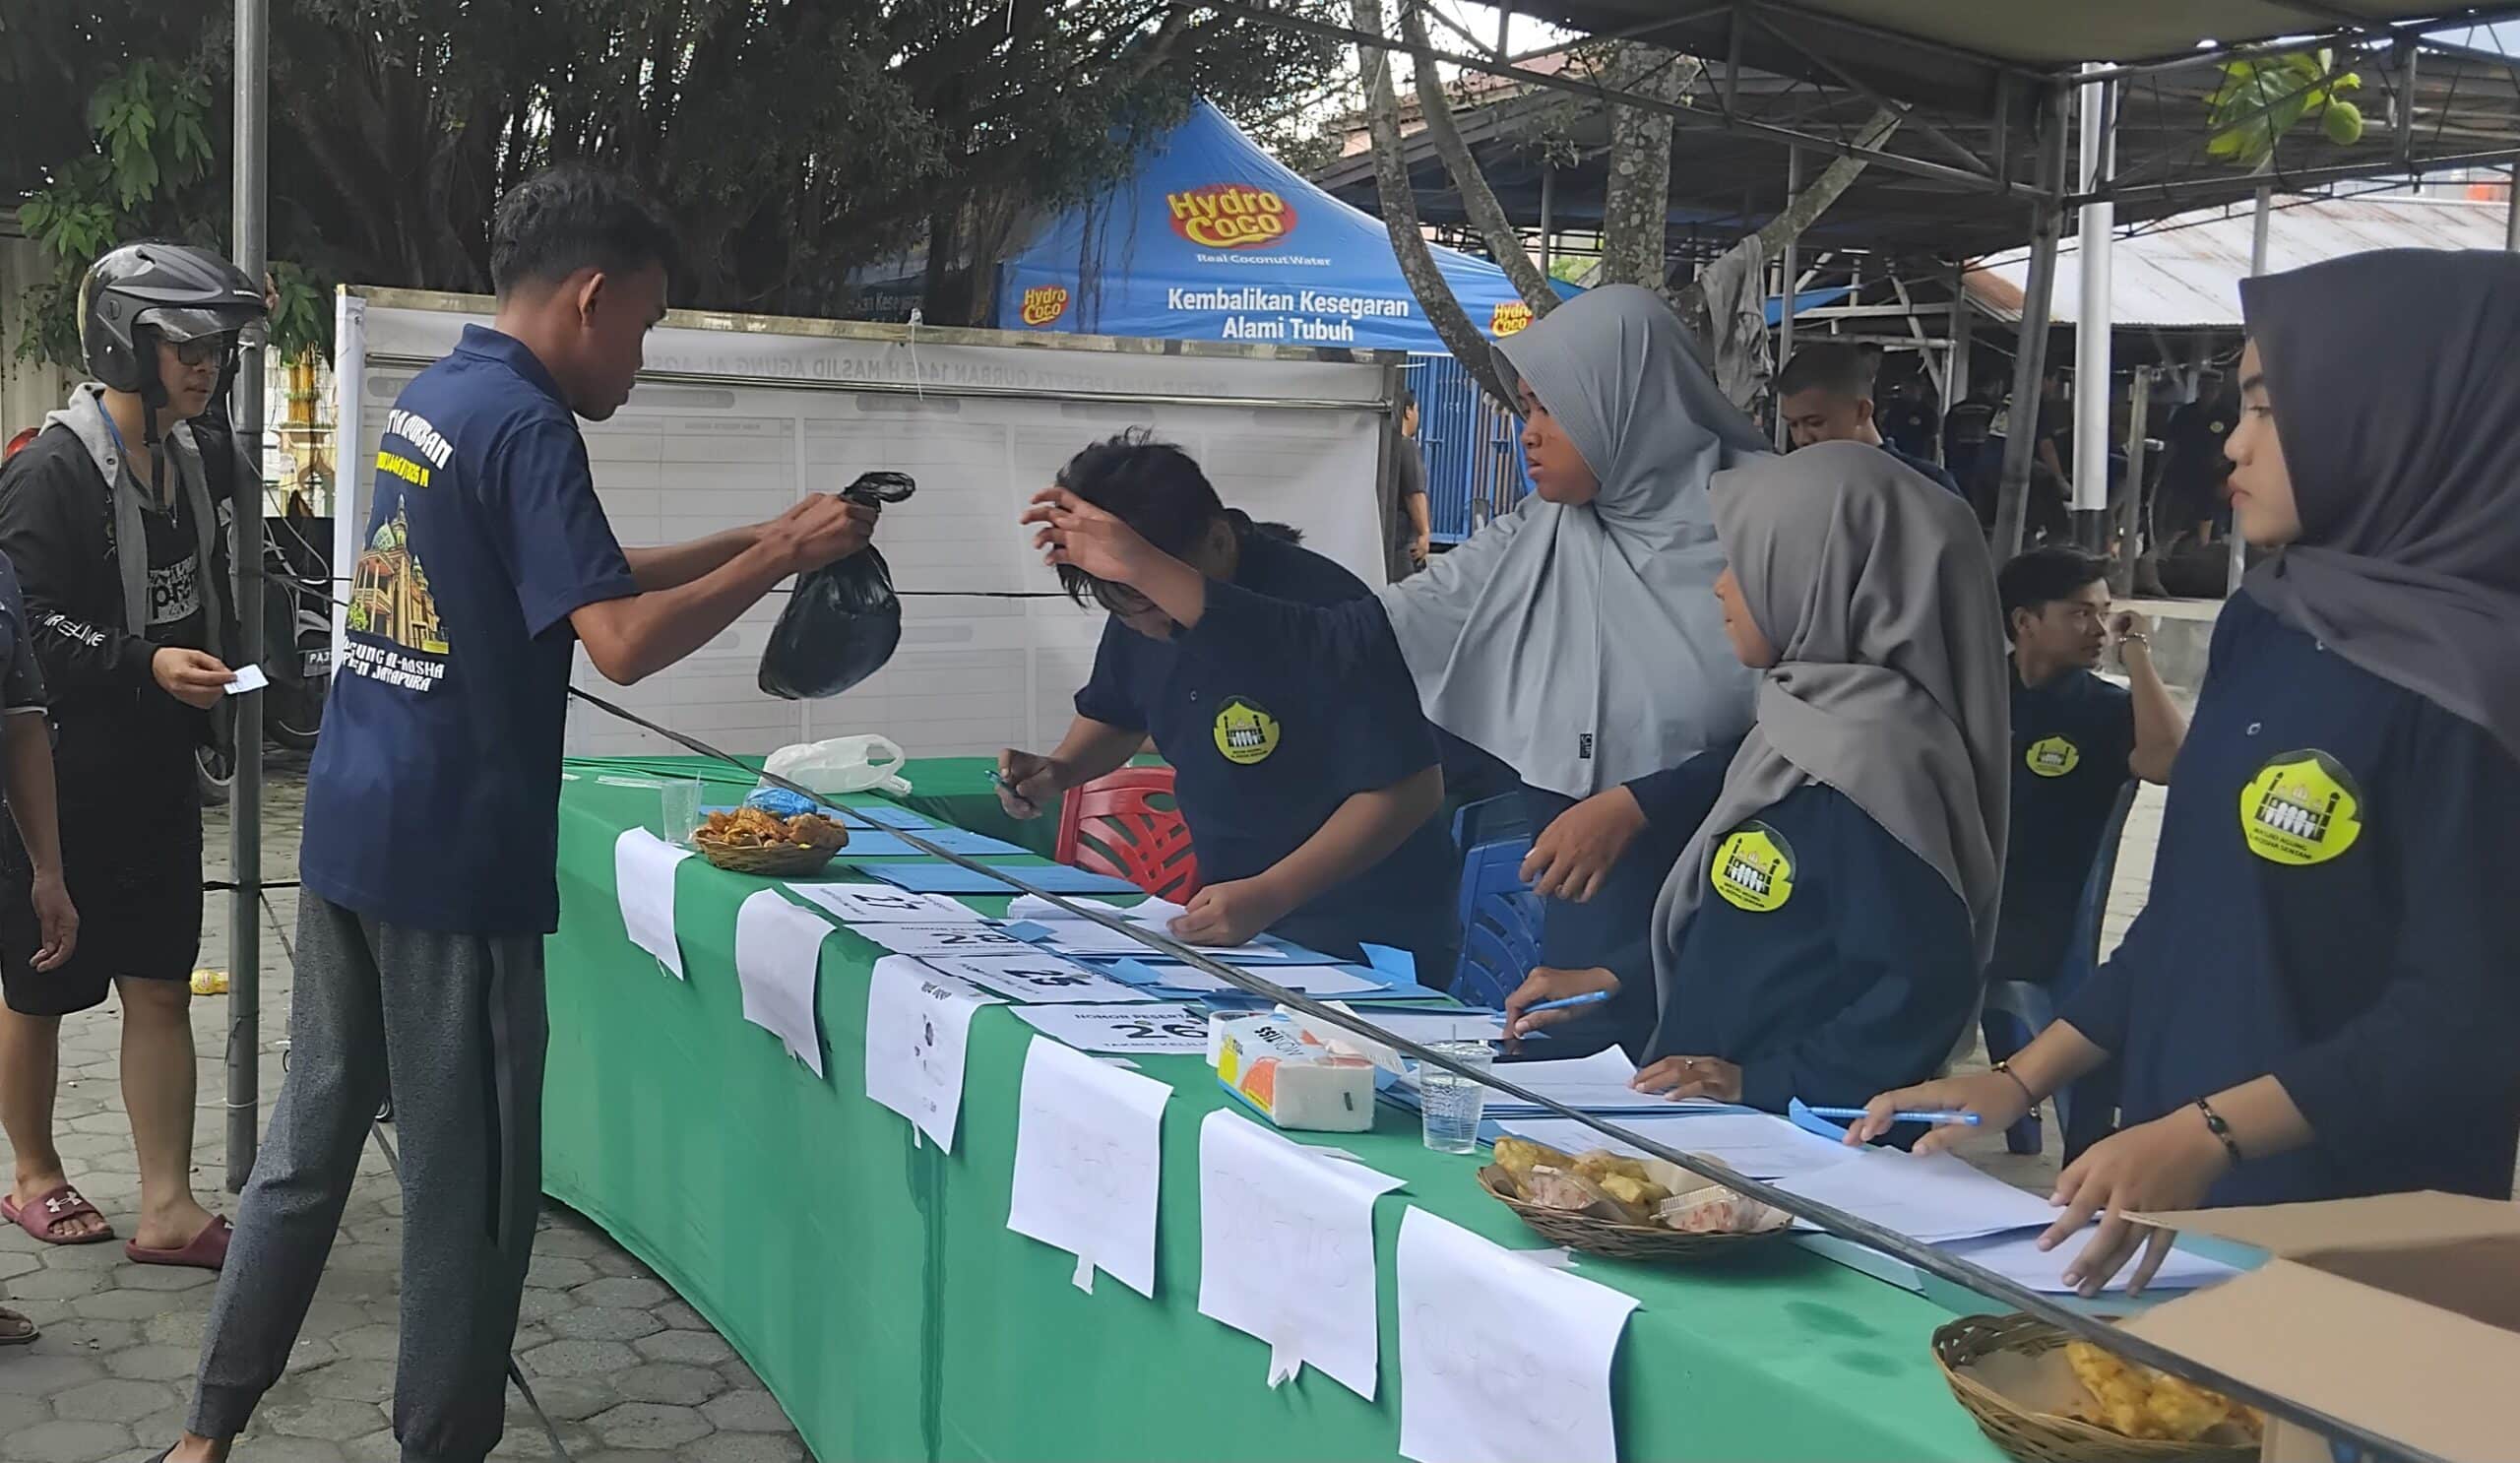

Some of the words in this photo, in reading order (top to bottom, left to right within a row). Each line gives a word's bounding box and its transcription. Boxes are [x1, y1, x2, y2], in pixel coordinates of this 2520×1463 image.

[1167, 188, 1284, 220] Hydro
[1185, 214, 1284, 247] Coco
[1196, 252, 1228, 263] Real
[1230, 253, 1291, 265] Coconut
[1291, 255, 1331, 266] Water
[1024, 286, 1067, 305] Hydro
[1167, 286, 1294, 311] Kembalikan
[1299, 289, 1409, 320] Kesegaran
[1023, 302, 1061, 325] Coco
[1222, 316, 1285, 339] Alami
[1290, 317, 1354, 342] Tubuh
[1492, 317, 1528, 337] Coco
[401, 414, 454, 471] QURBAN
[1002, 969, 1093, 986] 25
[1109, 1023, 1208, 1039] 26
